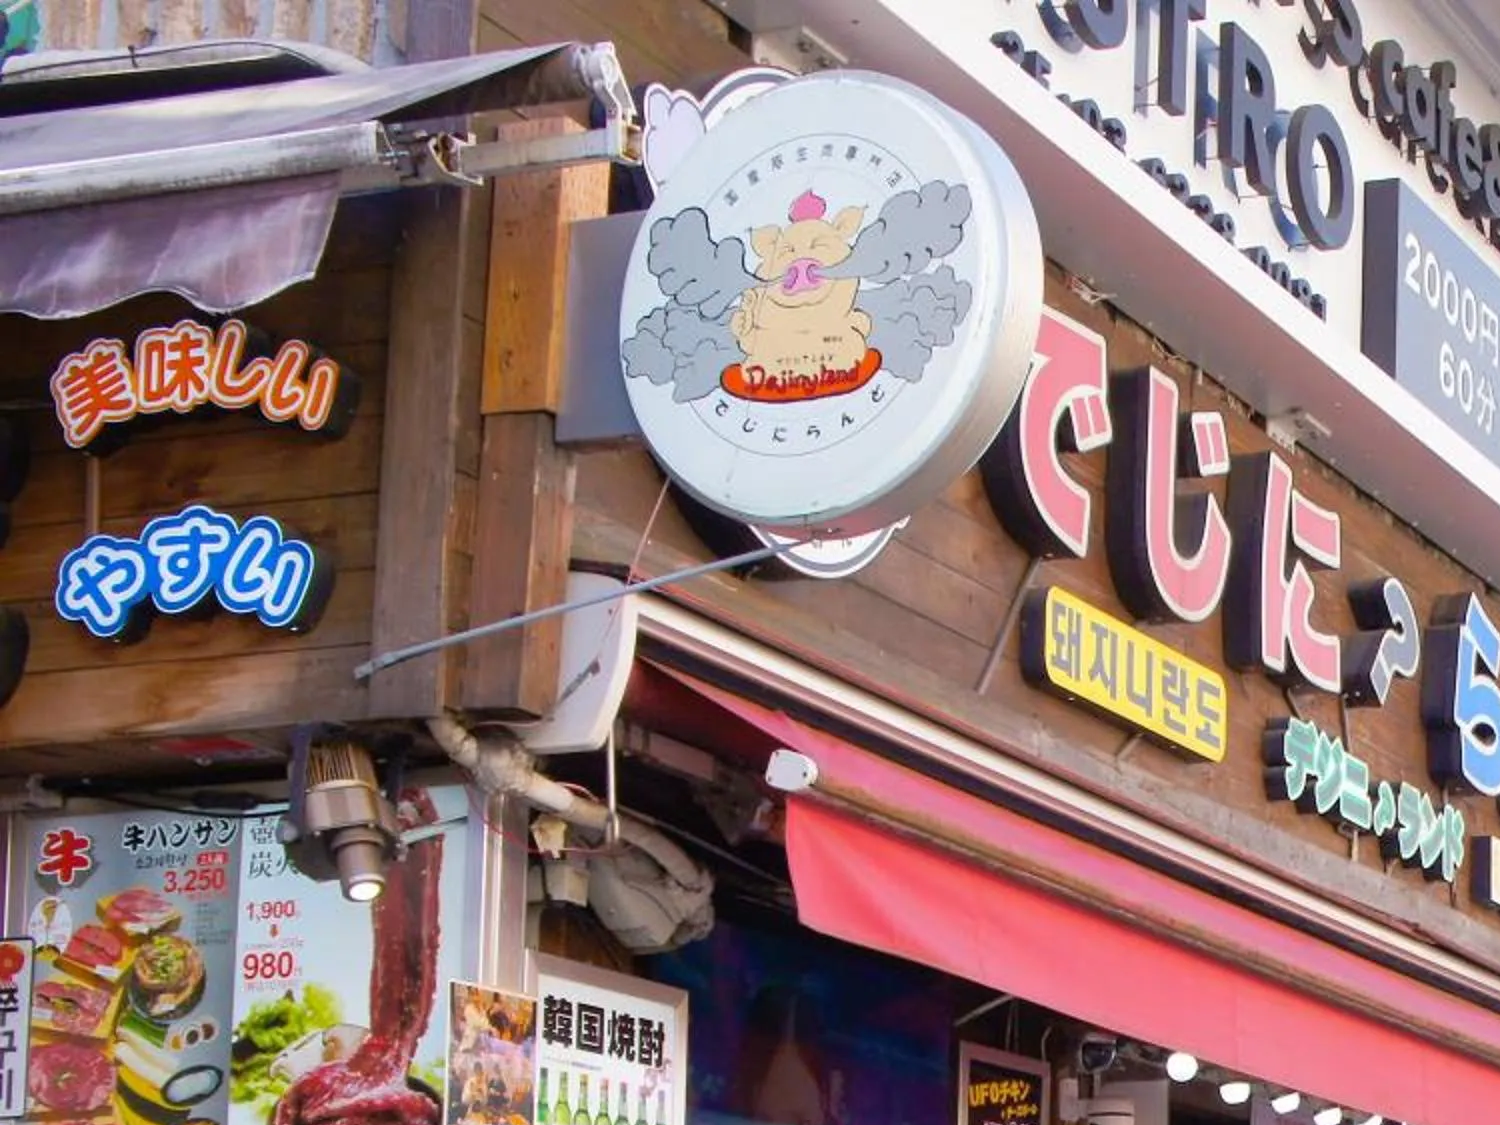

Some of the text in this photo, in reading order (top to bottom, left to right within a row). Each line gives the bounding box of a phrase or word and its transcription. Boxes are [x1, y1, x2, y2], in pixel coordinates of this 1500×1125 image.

[1062, 0, 1355, 250] TRO
[1404, 234, 1500, 368] 2000円
[54, 321, 338, 446] 美味しい
[1437, 340, 1497, 436] 60分
[60, 508, 311, 634] やすい
[1050, 603, 1224, 751] 돼지니란도
[40, 830, 92, 884] 牛
[123, 819, 237, 851] 牛ハンサン
[163, 869, 226, 894] 3,250
[245, 900, 296, 923] 1,900
[243, 950, 294, 981] 980
[542, 994, 666, 1069] 韓国焼酎
